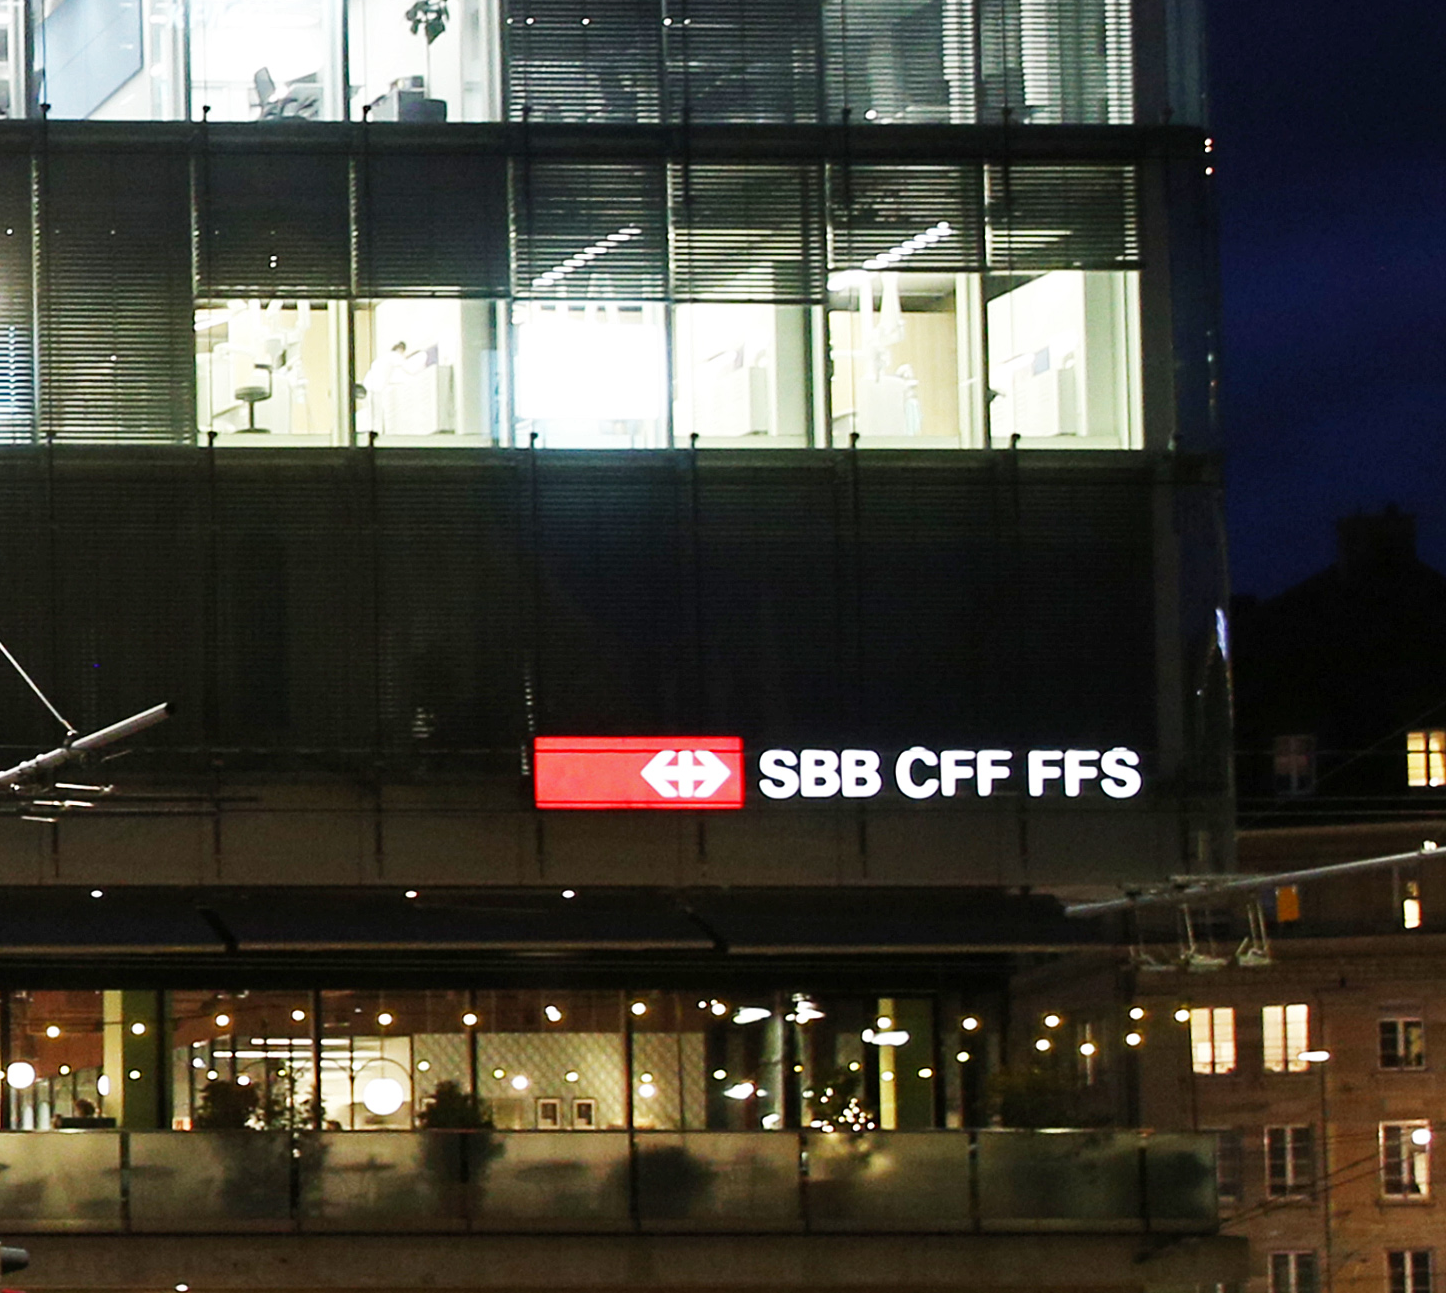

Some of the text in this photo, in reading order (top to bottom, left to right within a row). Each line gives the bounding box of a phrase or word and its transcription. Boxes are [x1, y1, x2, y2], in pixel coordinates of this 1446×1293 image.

[758, 746, 1142, 798] SBB CFF FFS
